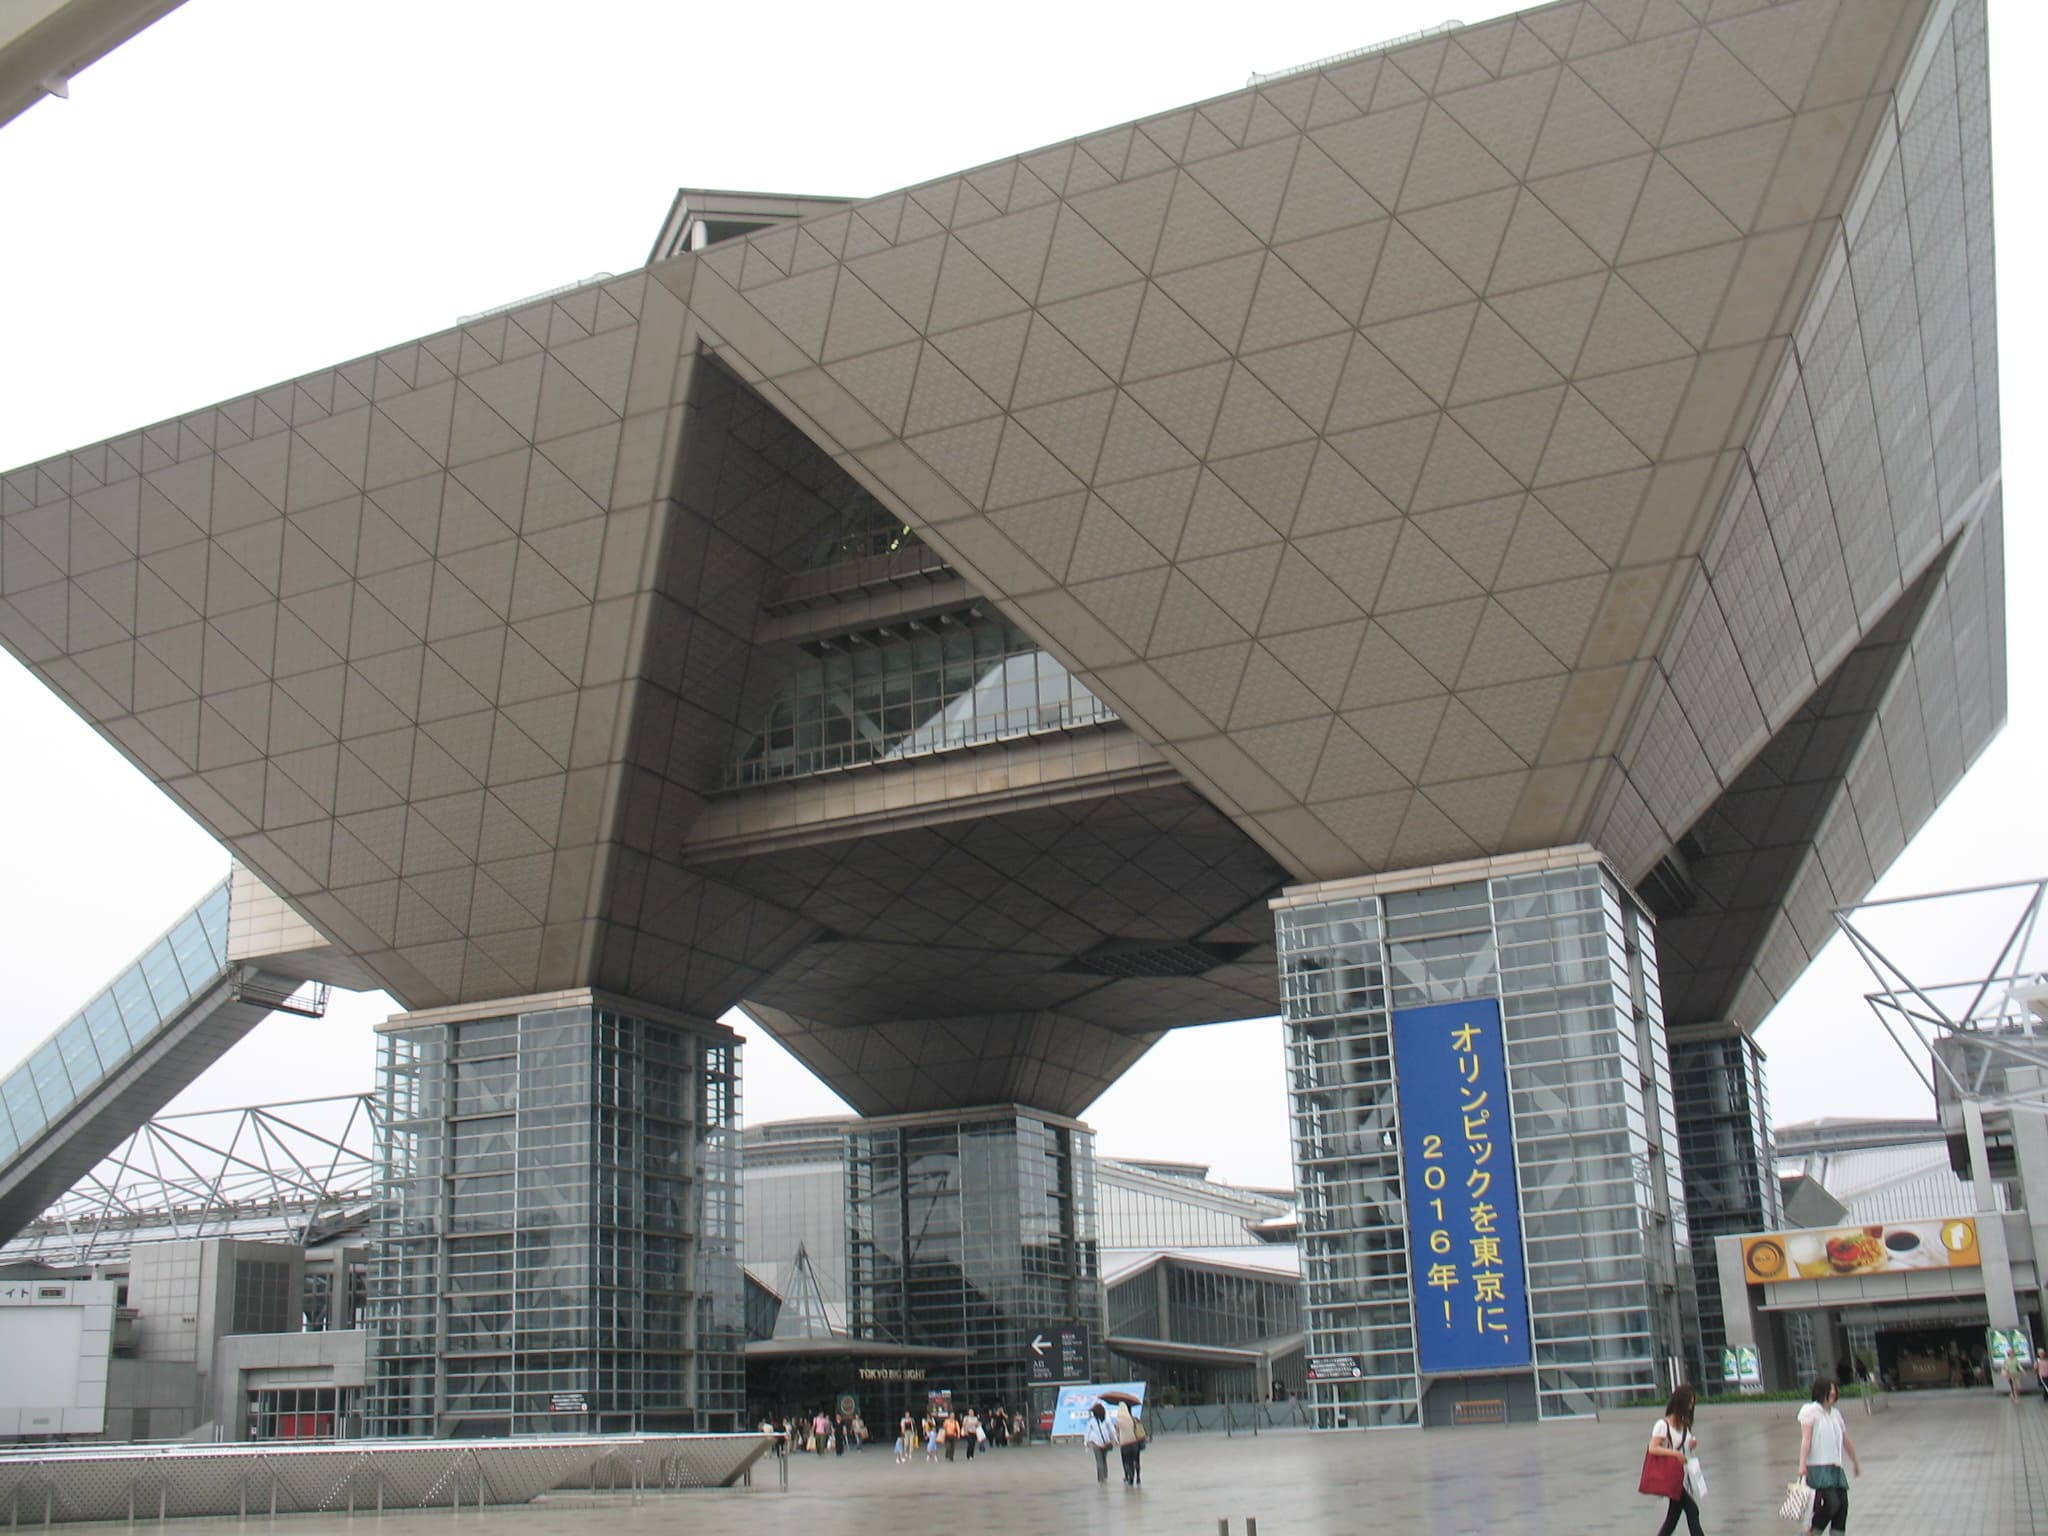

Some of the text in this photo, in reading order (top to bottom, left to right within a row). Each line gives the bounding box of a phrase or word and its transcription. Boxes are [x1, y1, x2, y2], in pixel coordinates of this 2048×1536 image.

[1450, 1022, 1510, 1345] オリンピックを東京に、
[859, 1368, 926, 1380] TOKYO BIG SIGHT
